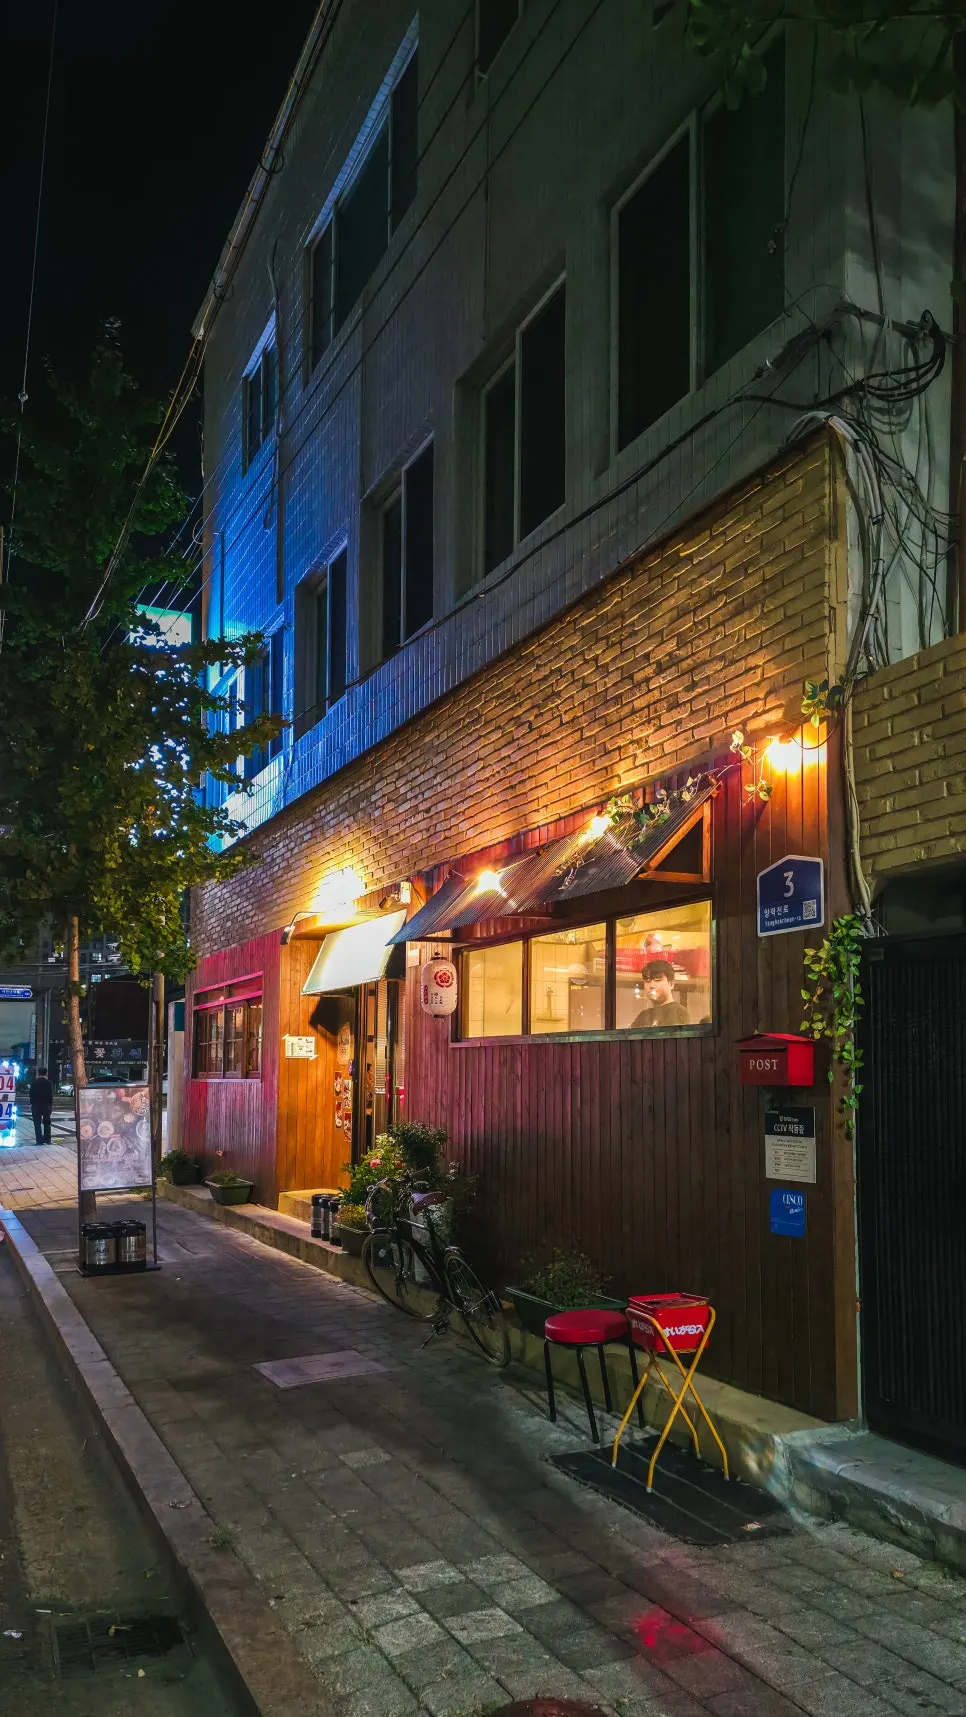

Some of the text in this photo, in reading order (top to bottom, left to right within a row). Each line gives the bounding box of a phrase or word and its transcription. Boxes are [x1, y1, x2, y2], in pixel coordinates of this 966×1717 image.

[783, 871, 795, 898] 3
[749, 1059, 778, 1071] POST
[773, 1123, 805, 1135] CCTV 작동중
